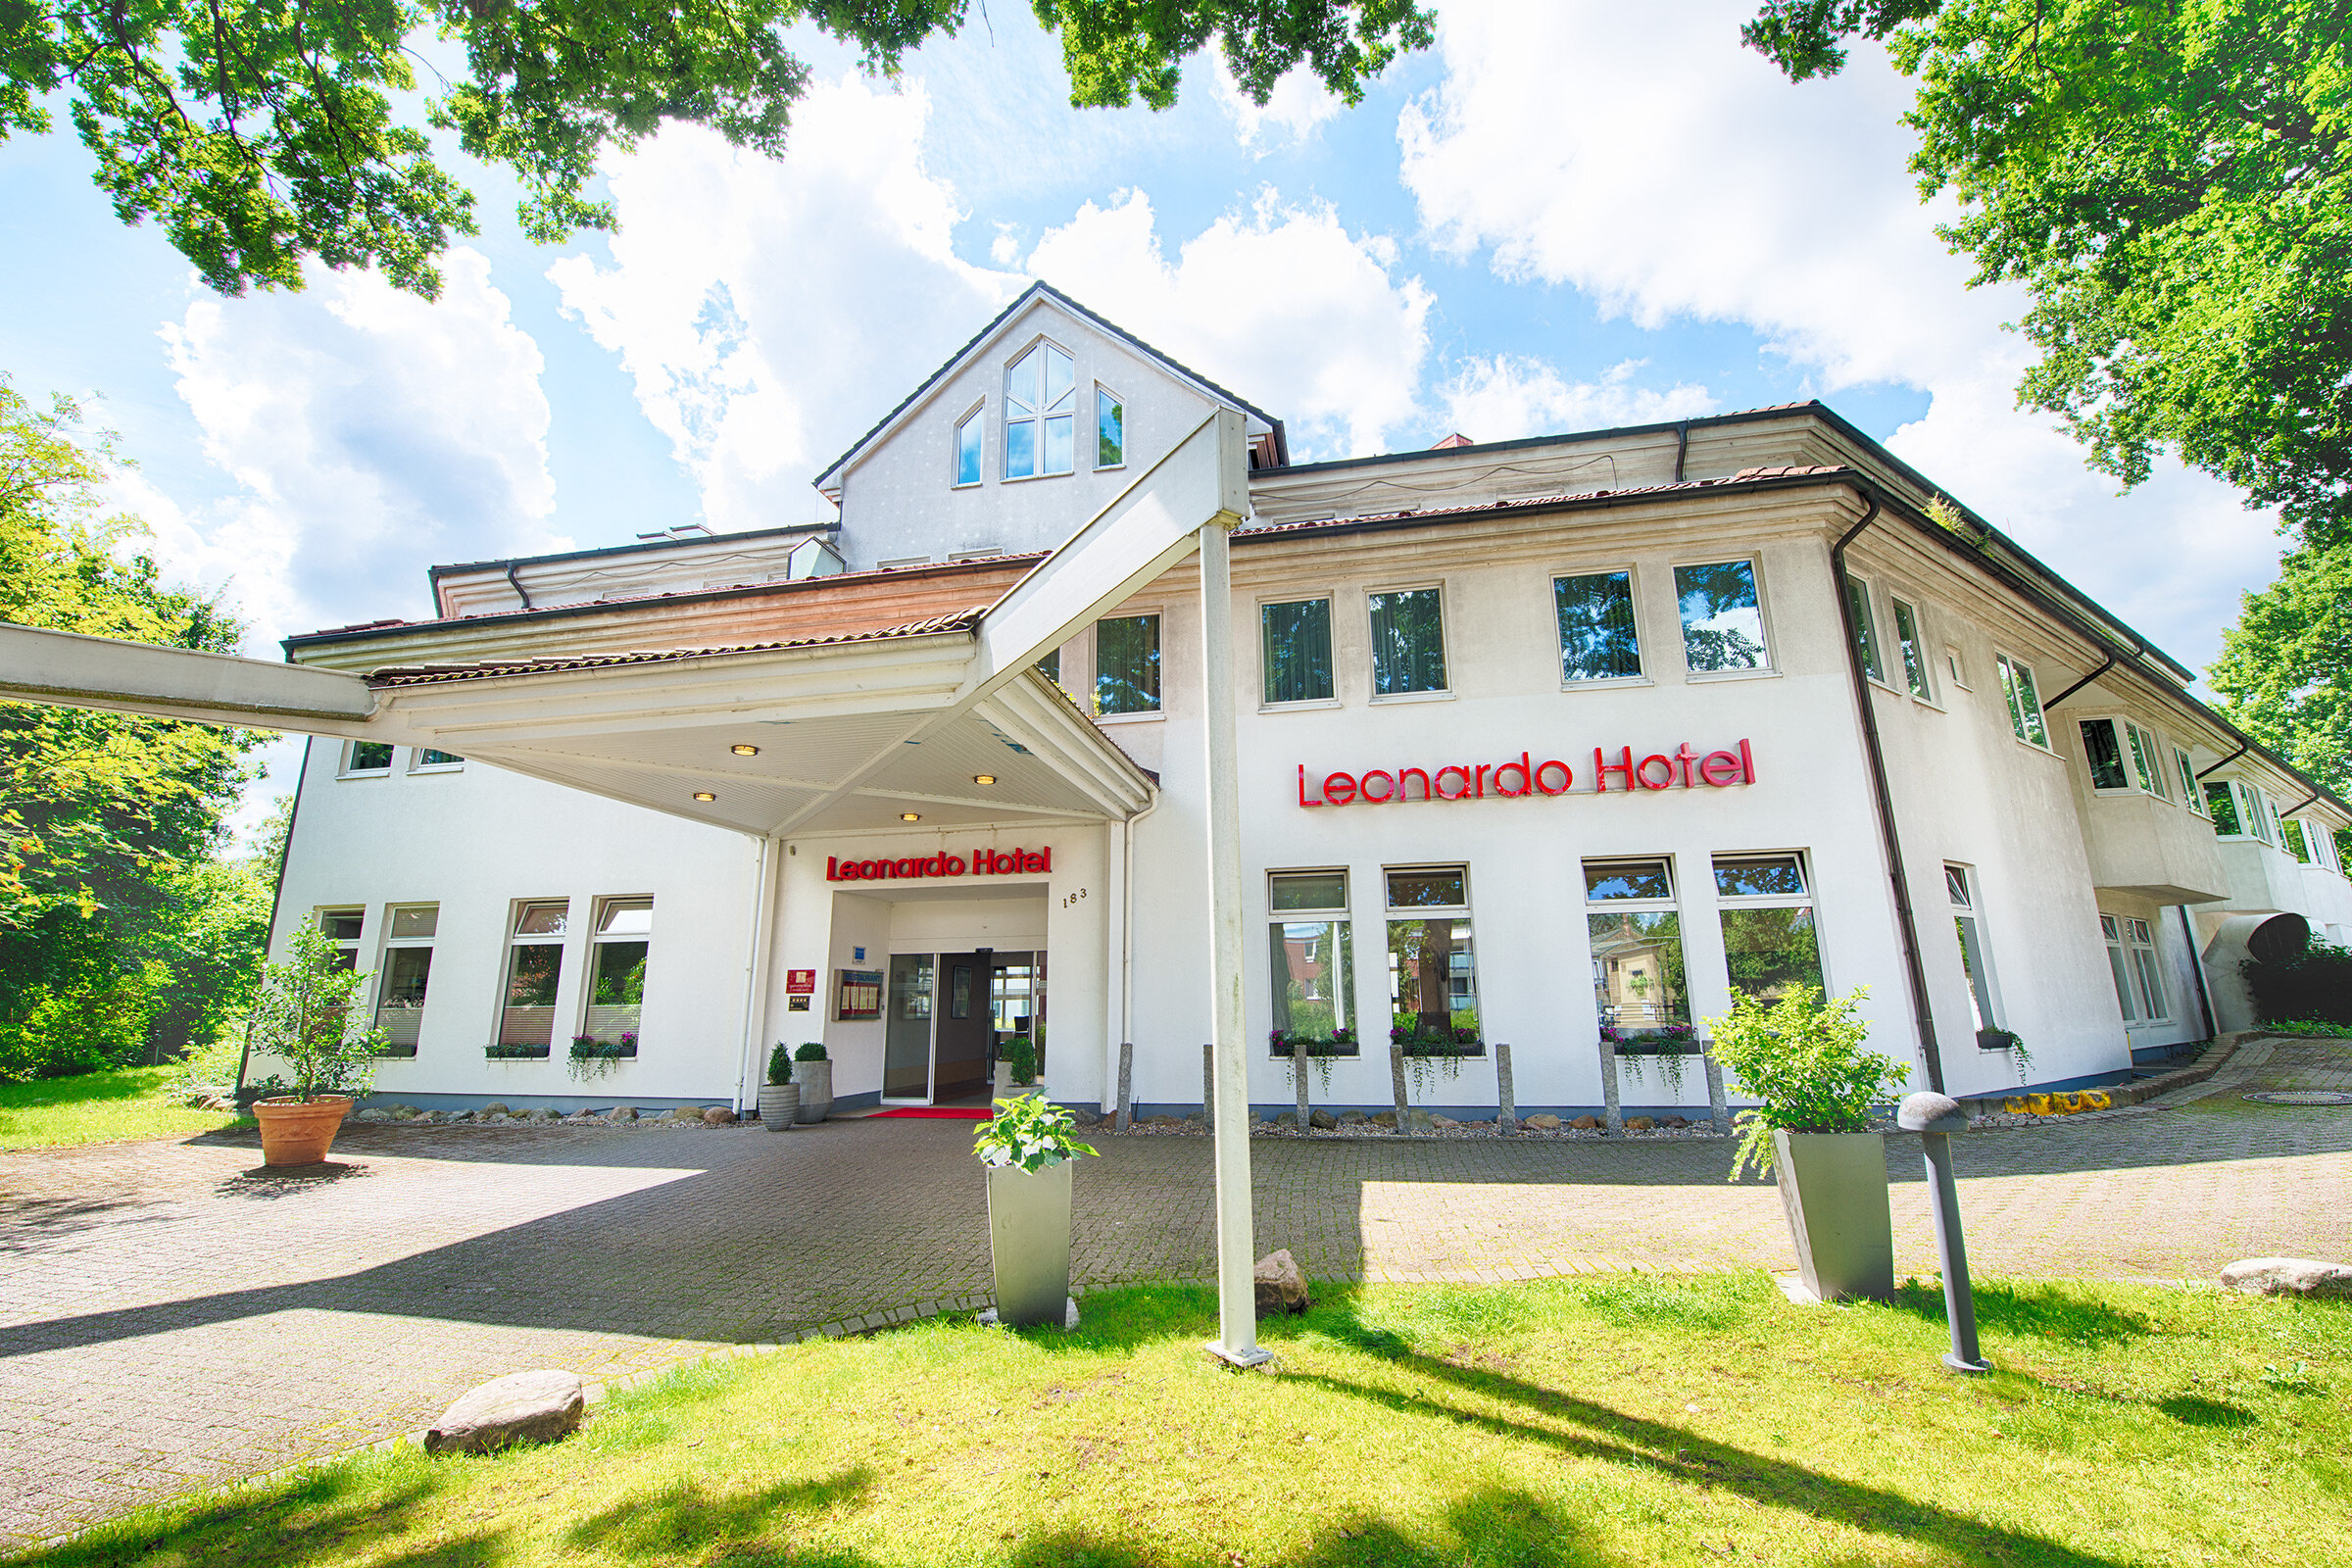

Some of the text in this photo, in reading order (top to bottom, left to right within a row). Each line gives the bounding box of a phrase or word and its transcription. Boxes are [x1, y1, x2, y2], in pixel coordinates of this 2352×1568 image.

[1298, 738, 1756, 808] Leonardo Hotel
[826, 846, 1052, 881] Leonardo Hotel
[1063, 888, 1087, 908] 183
[845, 972, 881, 982] RESTAURANT
